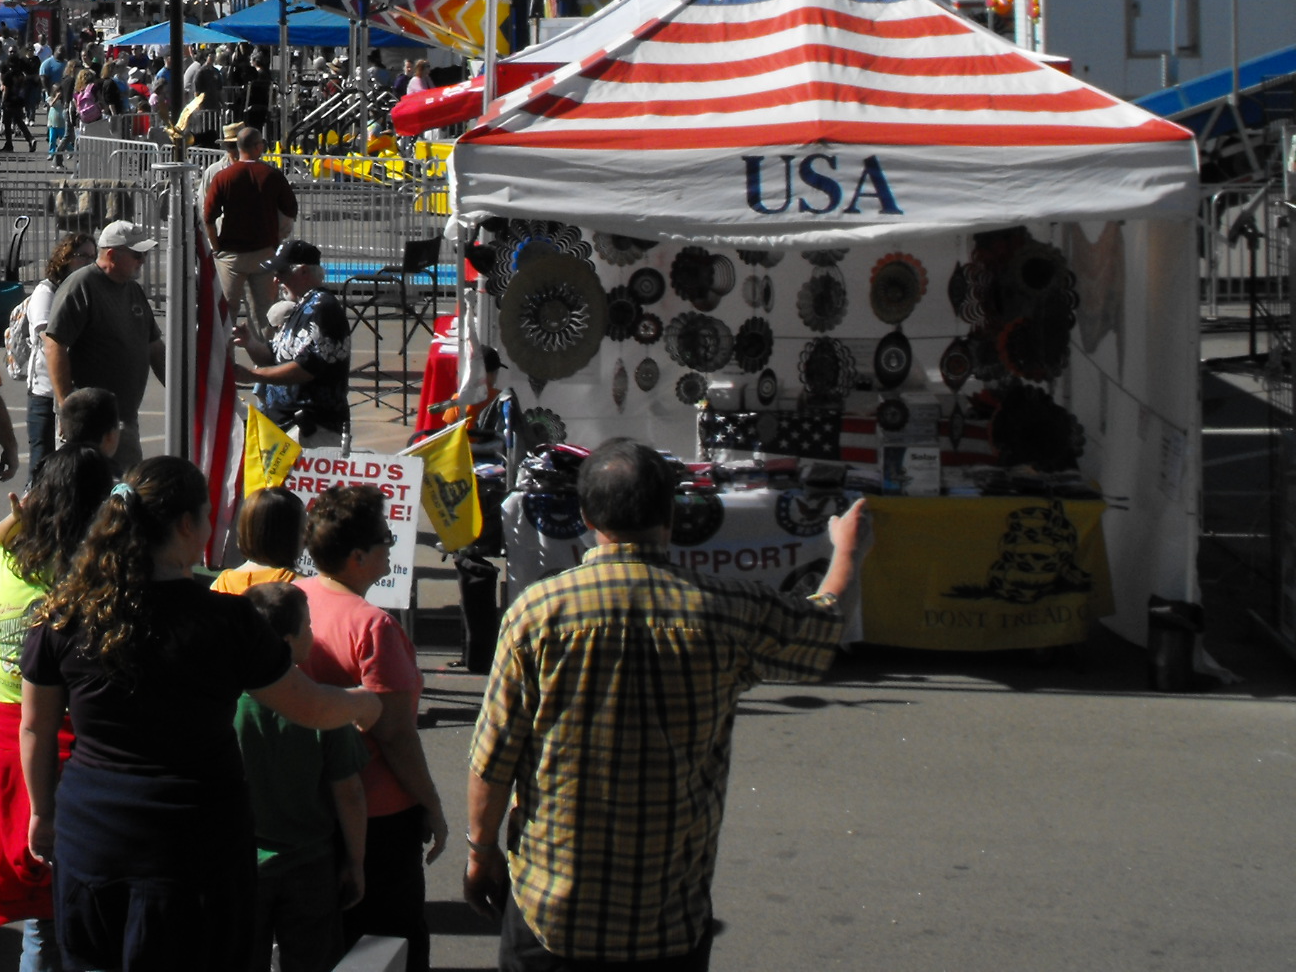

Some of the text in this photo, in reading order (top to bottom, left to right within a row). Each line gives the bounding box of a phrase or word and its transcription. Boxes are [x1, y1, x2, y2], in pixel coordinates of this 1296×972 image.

[742, 153, 904, 215] USA
[294, 456, 403, 480] WORLD'S
[393, 564, 408, 575] the
[666, 542, 802, 574] UPPORT
[924, 610, 987, 629] DONT
[1001, 604, 1072, 628] TREAD
